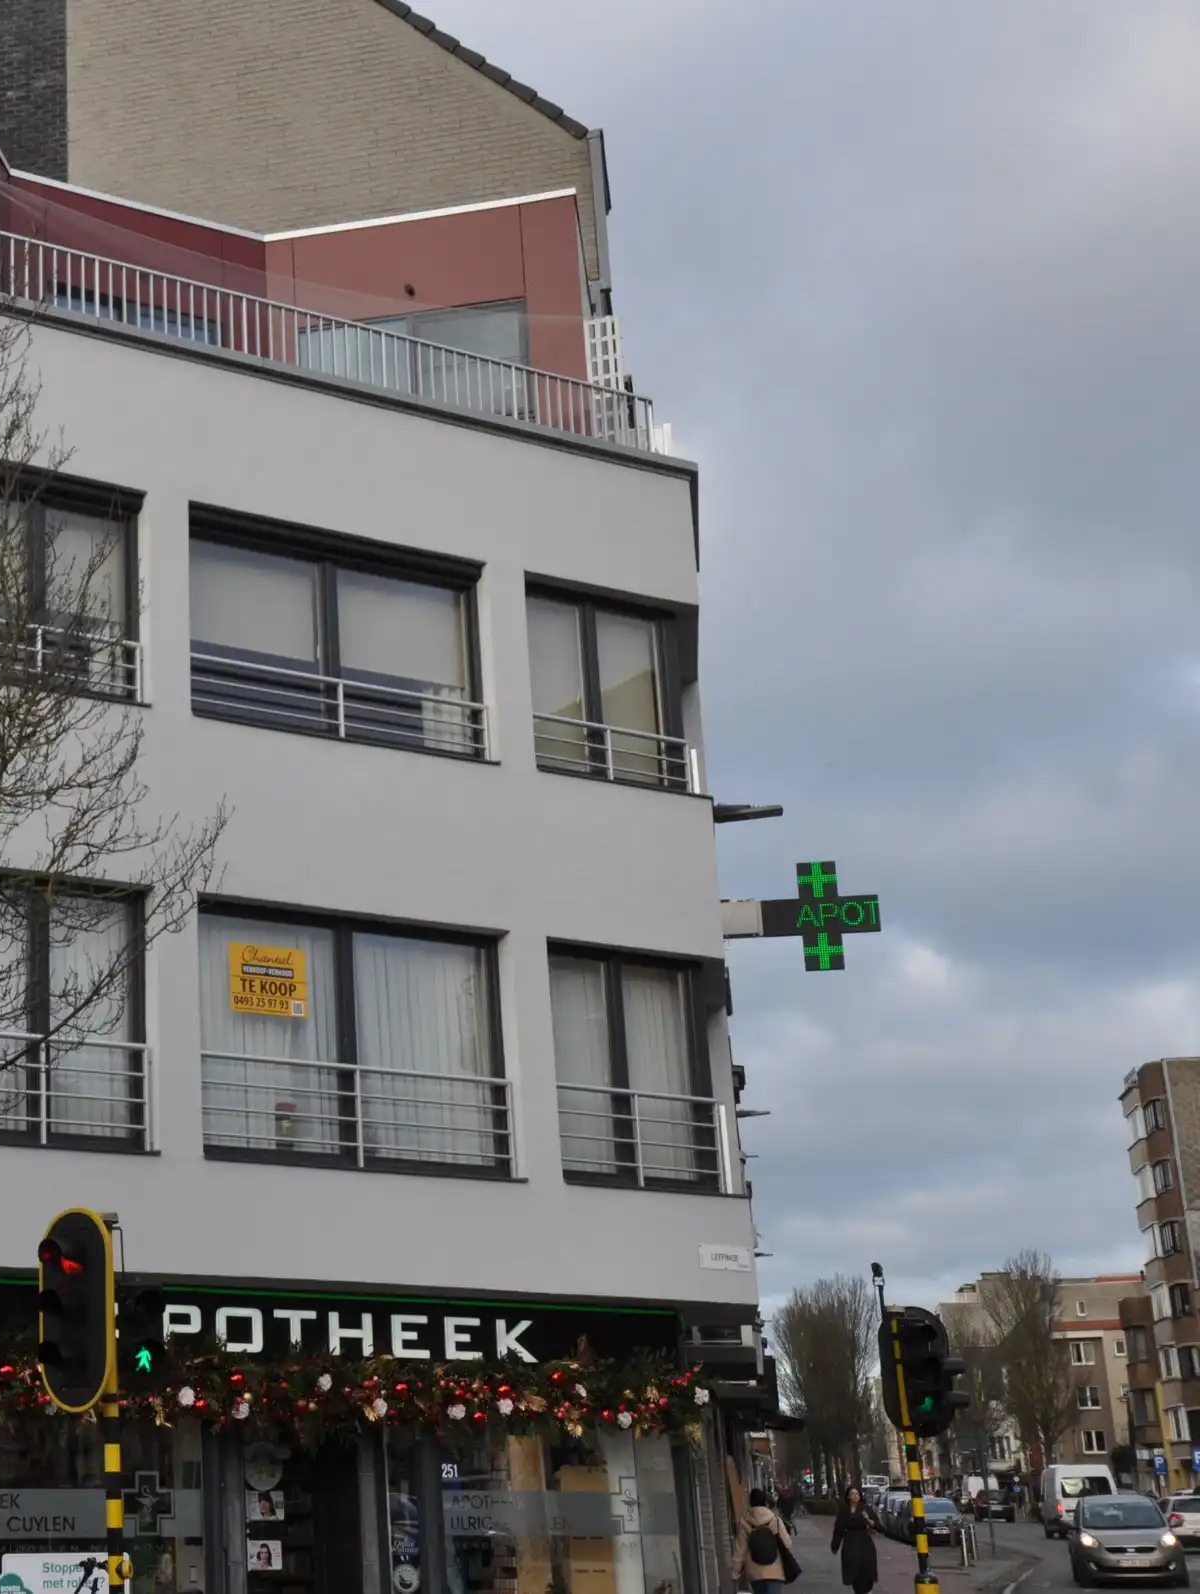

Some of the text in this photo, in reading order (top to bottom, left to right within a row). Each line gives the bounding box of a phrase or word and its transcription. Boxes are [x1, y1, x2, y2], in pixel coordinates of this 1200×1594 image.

[796, 900, 880, 928] APOT
[242, 946, 293, 965] Chantal
[240, 979, 297, 997] TE KOOP
[234, 996, 254, 1006] 0493
[268, 999, 277, 1008] 97
[279, 1000, 289, 1010] 93
[162, 1304, 538, 1364] POTHEEK
[441, 1463, 458, 1478] 251
[1155, 1457, 1164, 1468] P
[7, 1515, 76, 1532] CUYLEN
[42, 1562, 87, 1576] Stoppe
[42, 1577, 64, 1588] met
